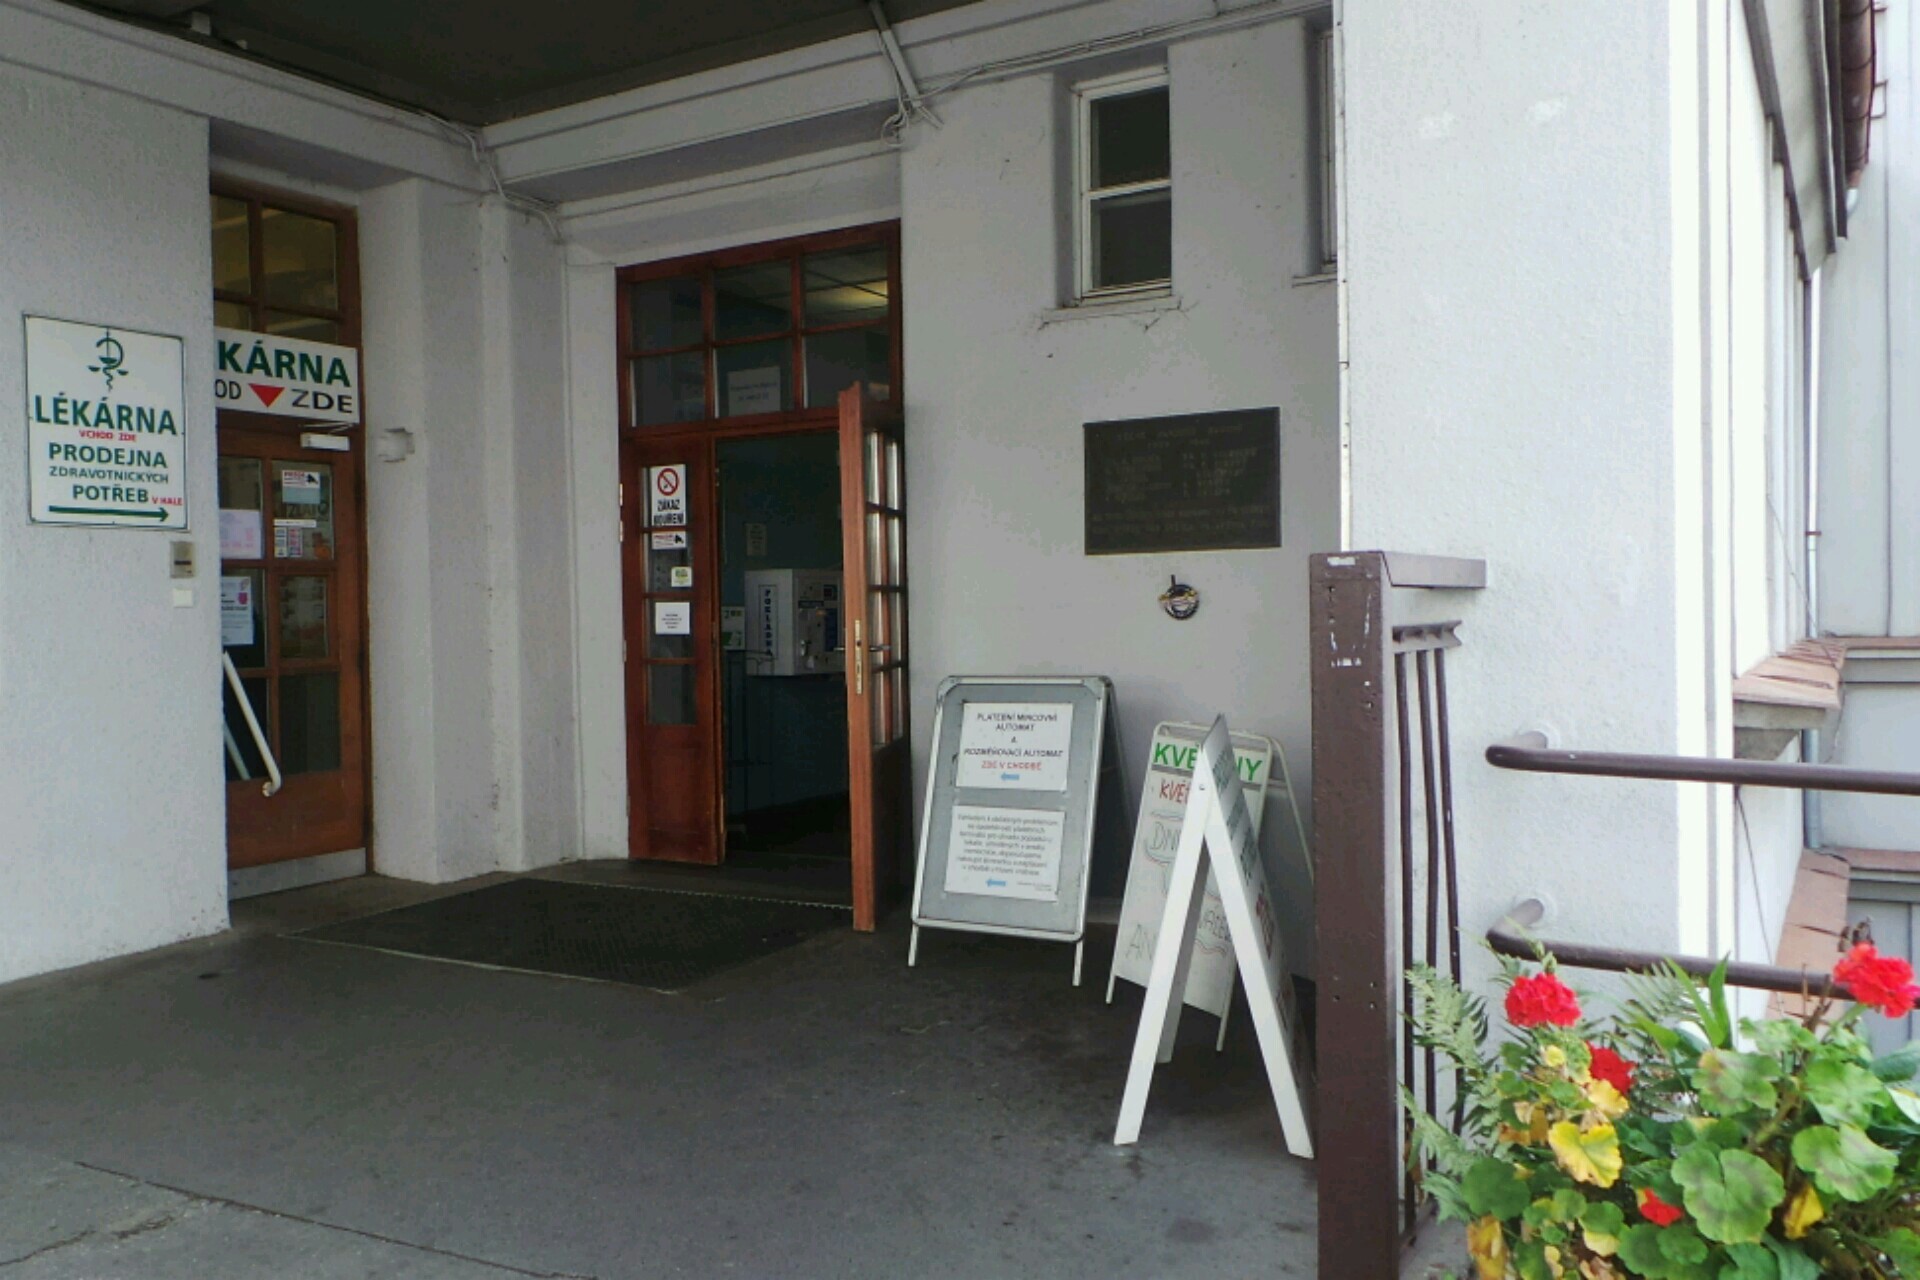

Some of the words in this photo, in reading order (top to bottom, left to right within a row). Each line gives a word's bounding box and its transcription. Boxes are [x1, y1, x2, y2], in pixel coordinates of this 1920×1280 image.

[217, 340, 352, 387] KÁRNA
[215, 379, 242, 400] OD
[291, 388, 353, 414] ZDE
[34, 391, 178, 435] LÉKÁRNA
[78, 429, 114, 440] VCHOD
[118, 432, 137, 443] ZDE
[48, 441, 168, 469] PRODEJNA
[72, 483, 149, 503] POTŘEB
